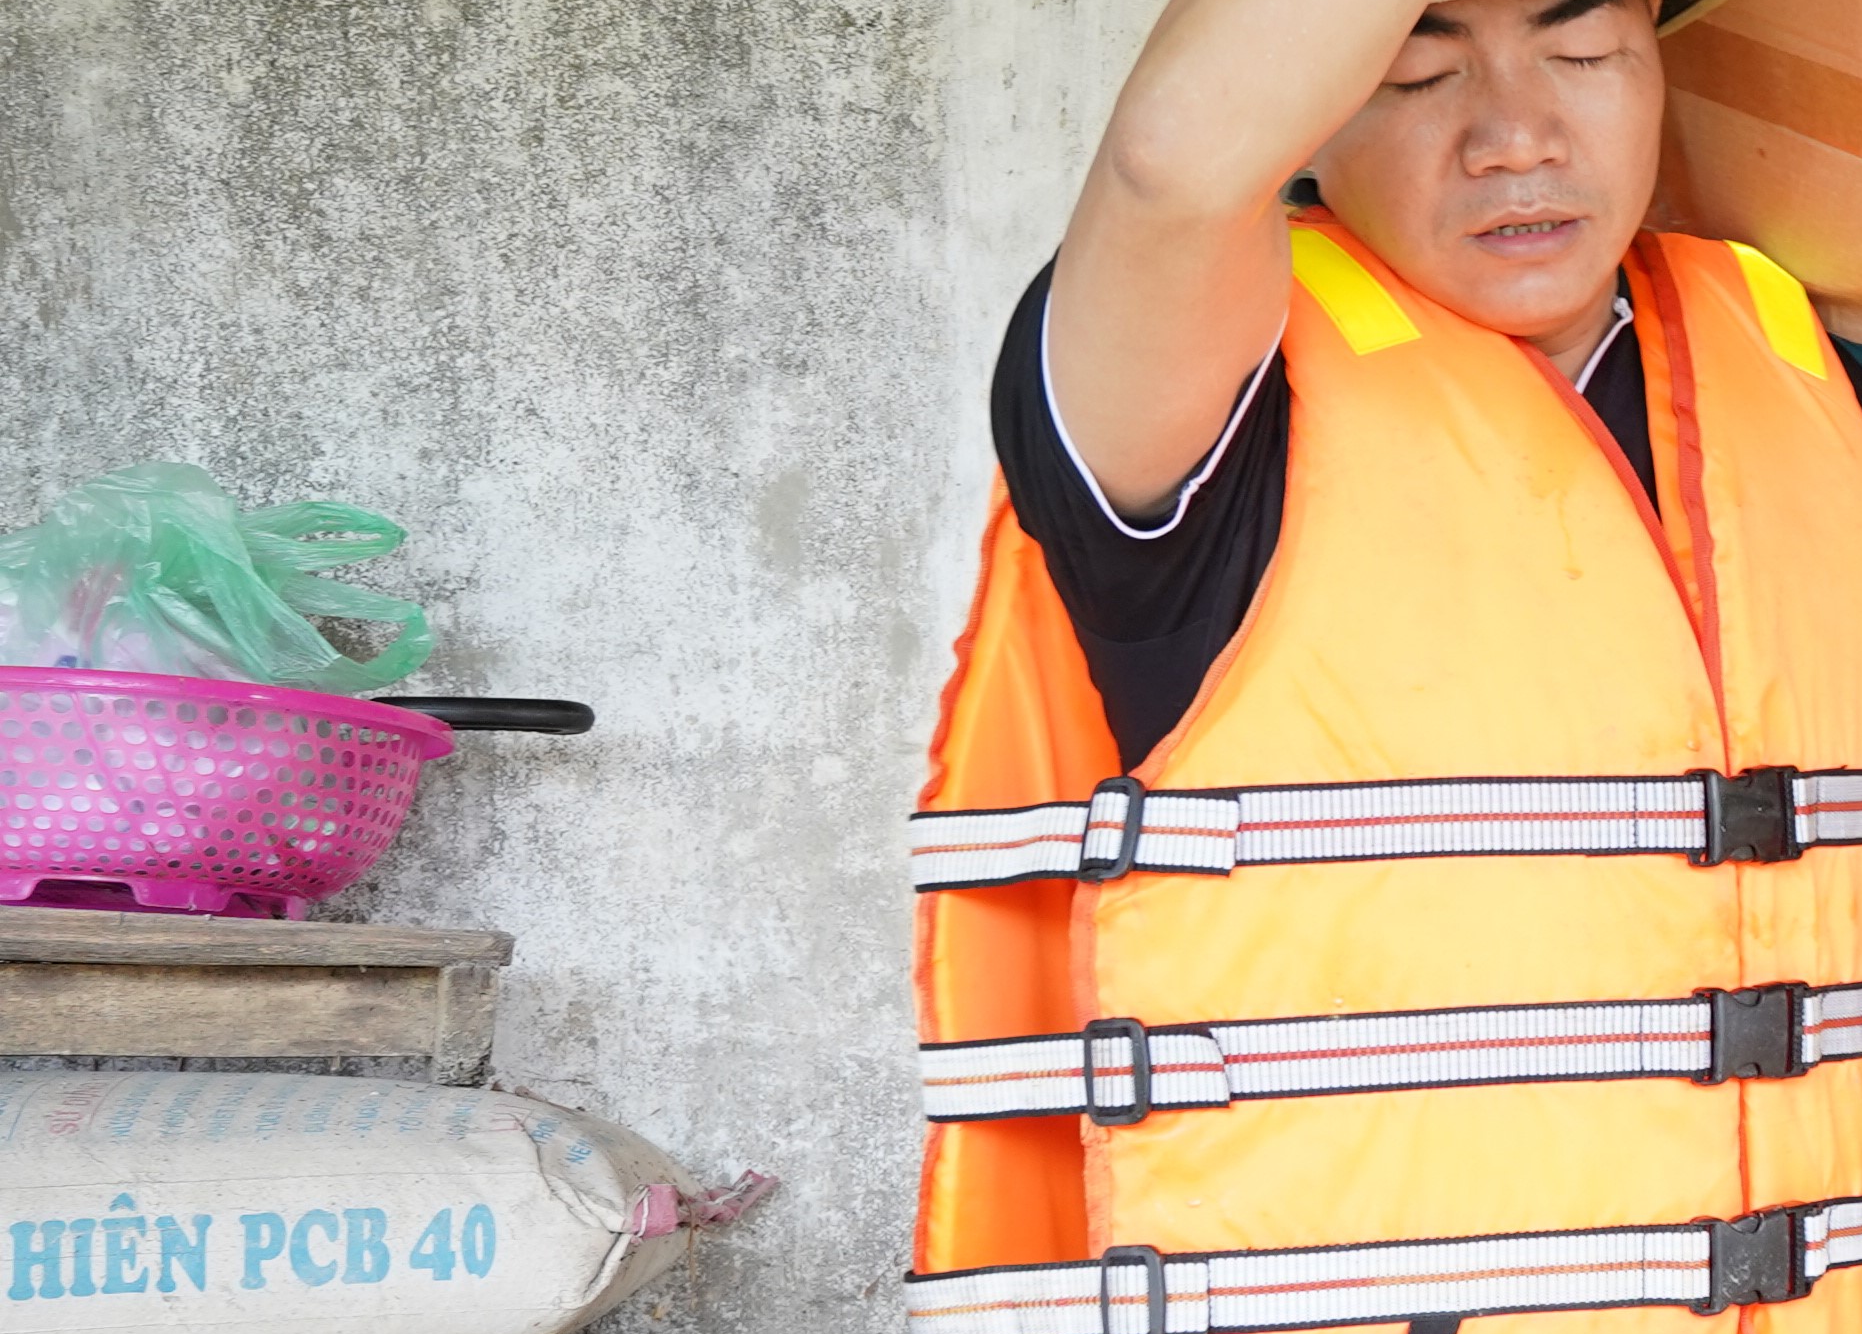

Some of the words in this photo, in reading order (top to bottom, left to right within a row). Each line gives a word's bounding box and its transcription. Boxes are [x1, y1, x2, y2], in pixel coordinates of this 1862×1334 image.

[9, 1192, 213, 1302] HIÊN
[240, 1207, 391, 1289] PCB
[409, 1203, 498, 1280] 40
